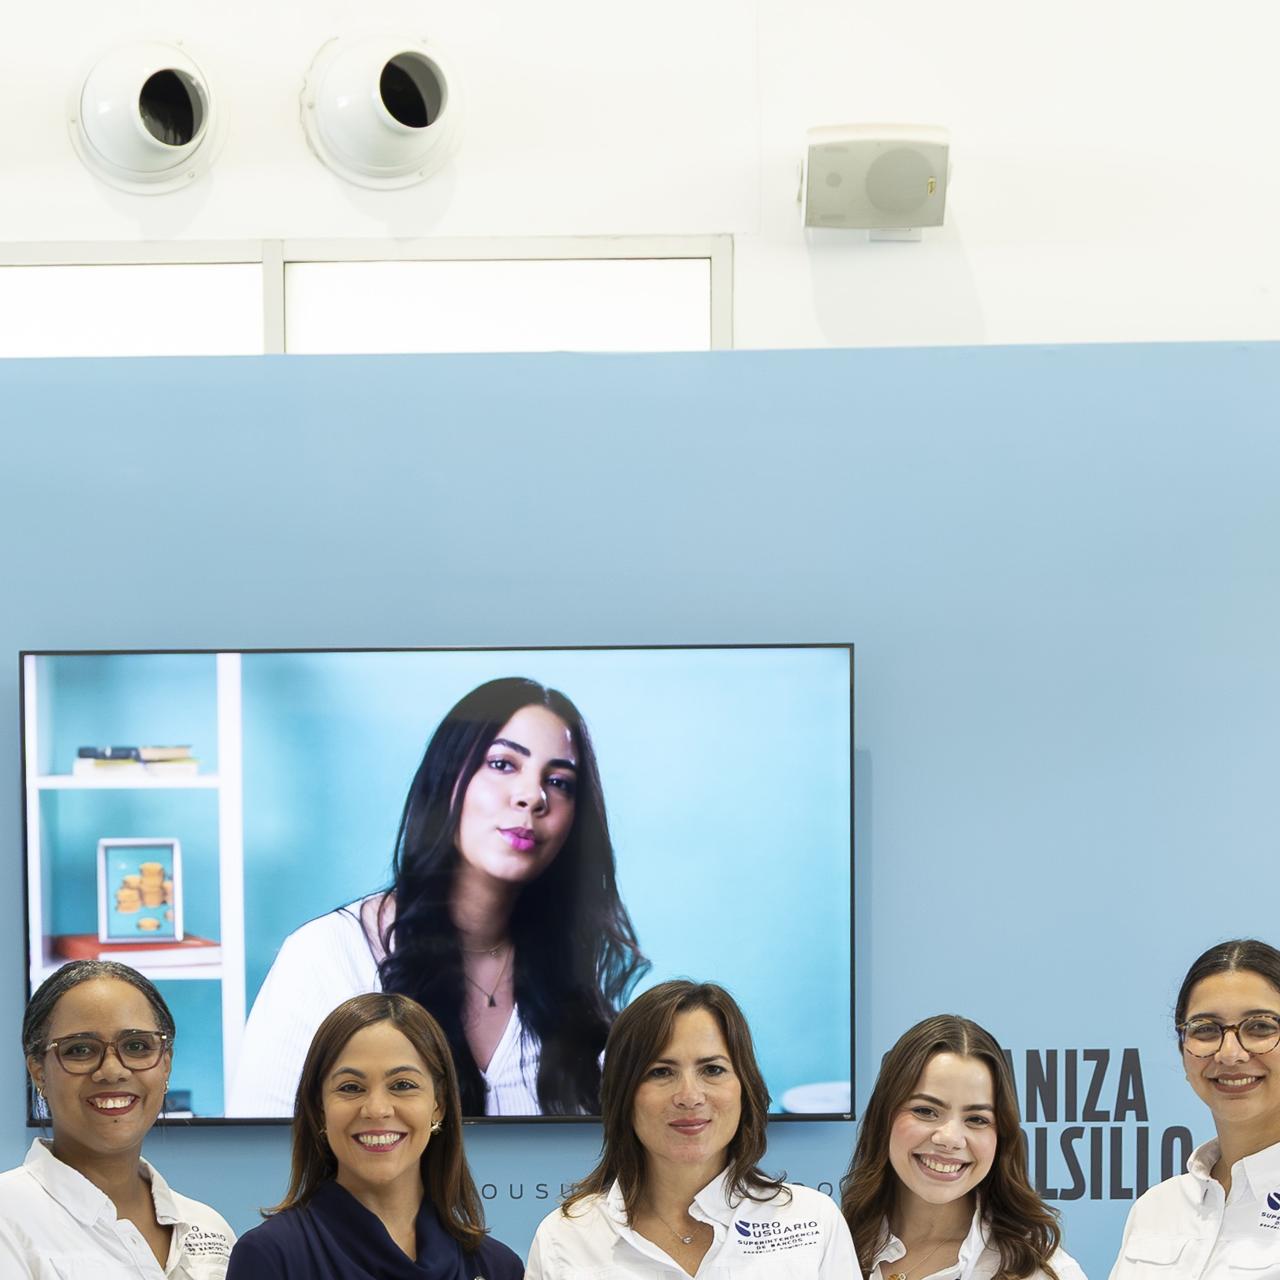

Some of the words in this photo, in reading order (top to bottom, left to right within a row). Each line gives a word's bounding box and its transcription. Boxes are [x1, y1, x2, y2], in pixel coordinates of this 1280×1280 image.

[1001, 1048, 1149, 1123] NIZA
[752, 1221, 781, 1230] PRO
[753, 1221, 818, 1238] USUARIO
